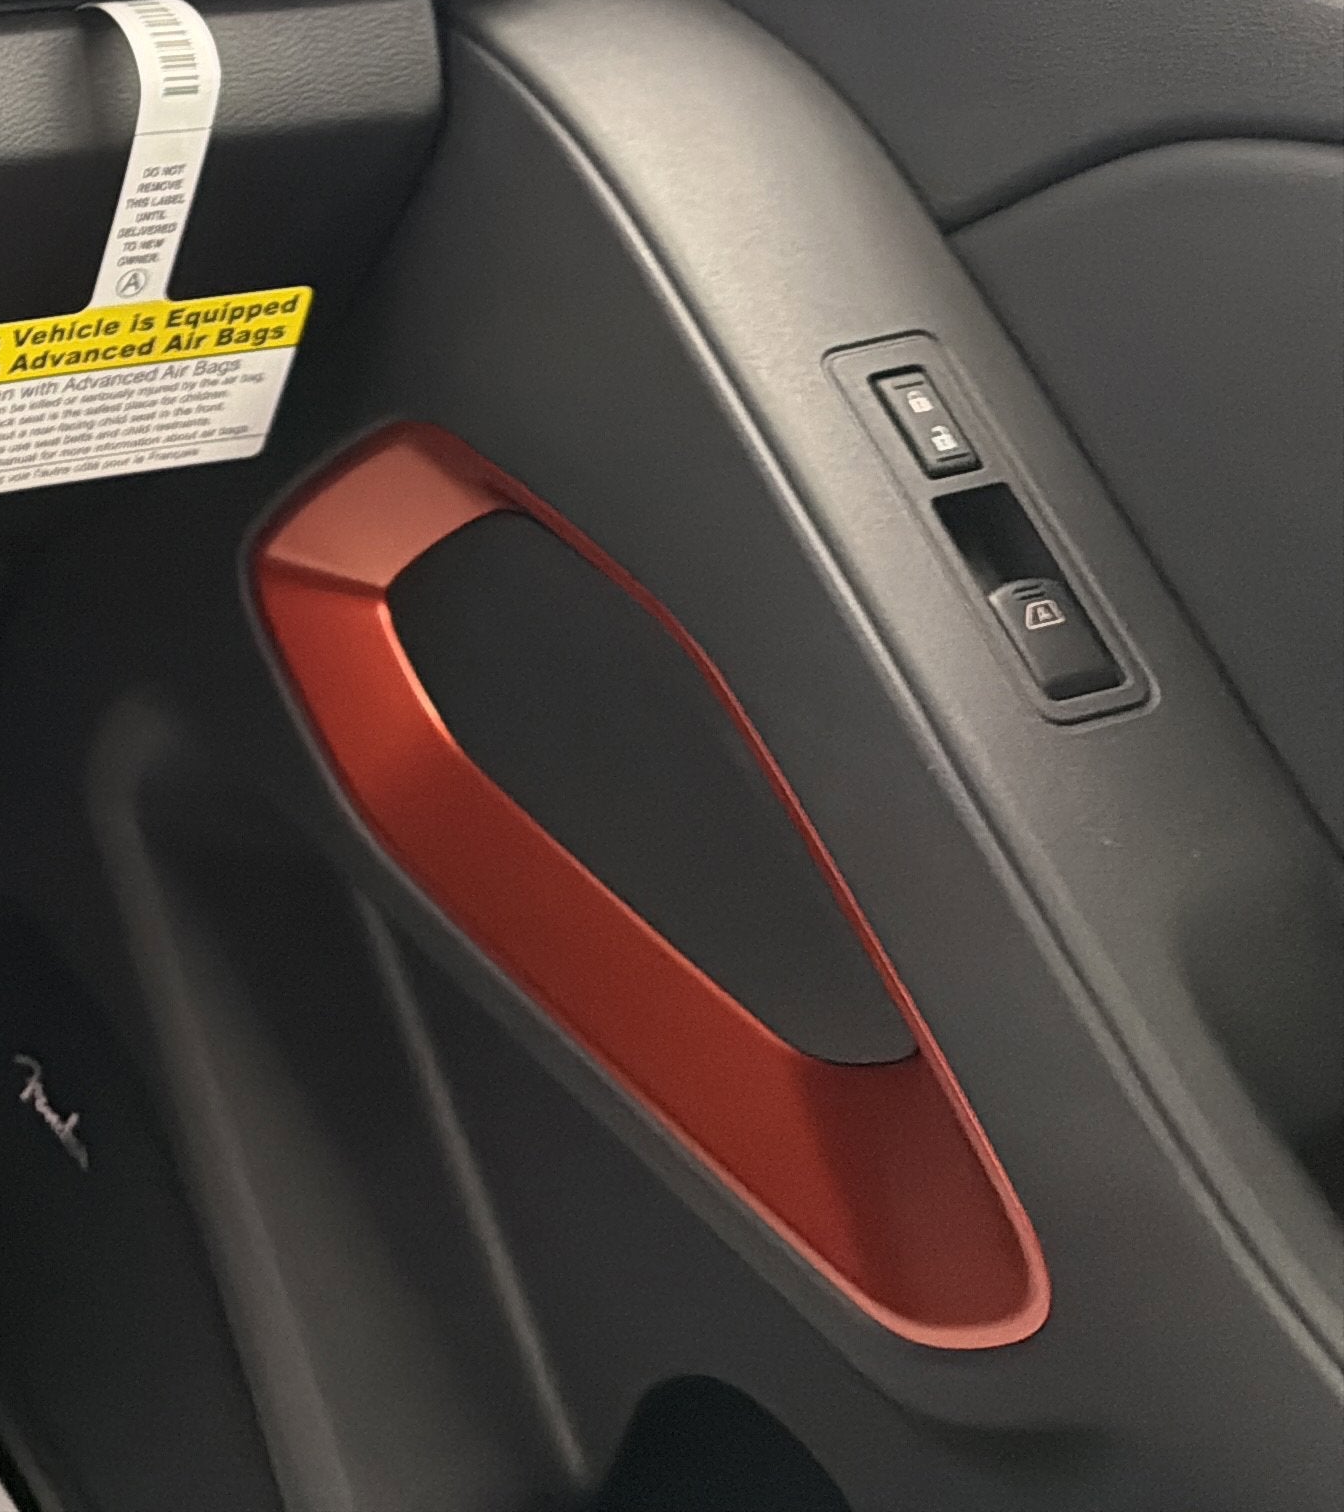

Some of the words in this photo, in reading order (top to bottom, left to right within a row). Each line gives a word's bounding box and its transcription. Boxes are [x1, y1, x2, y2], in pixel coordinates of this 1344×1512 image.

[13, 318, 120, 348] Vehicle
[130, 313, 156, 333] is
[165, 294, 300, 328] Equipped
[8, 336, 157, 375] Advanced
[163, 332, 210, 353] Air
[214, 324, 287, 347] Bags
[19, 379, 59, 398] with
[62, 365, 158, 393] Advanced
[161, 362, 190, 380] Air
[192, 355, 242, 379] Bags
